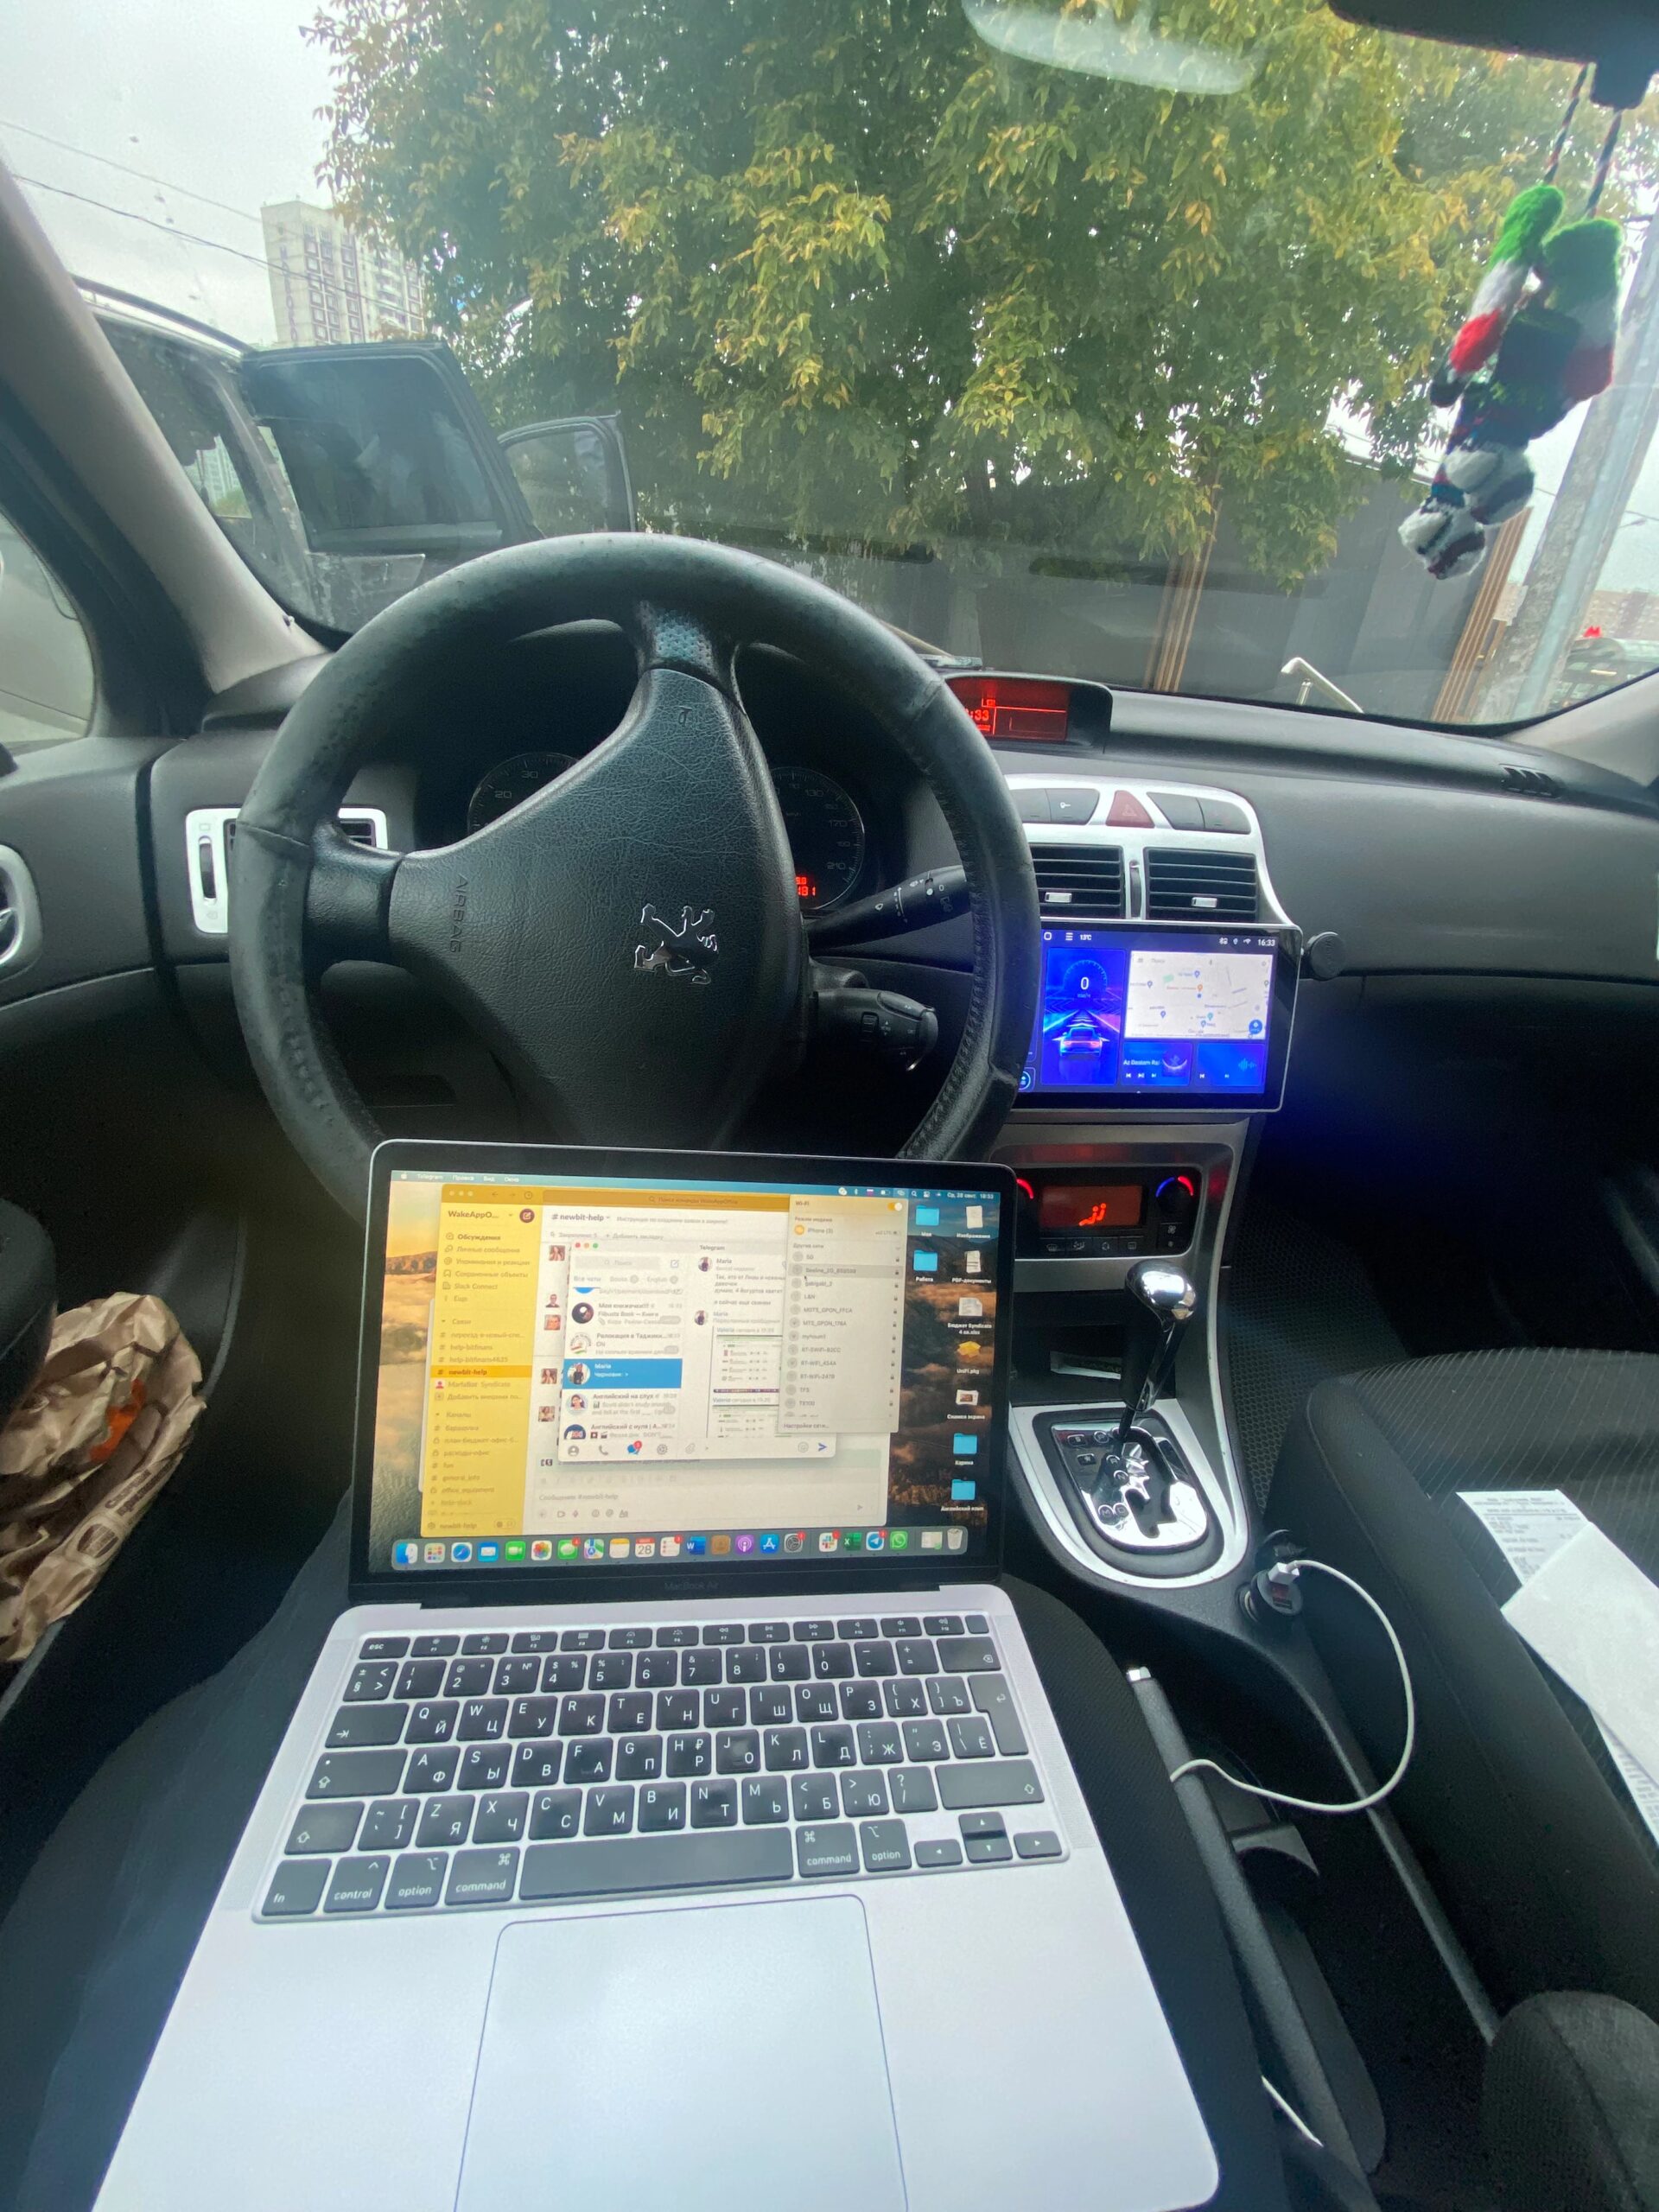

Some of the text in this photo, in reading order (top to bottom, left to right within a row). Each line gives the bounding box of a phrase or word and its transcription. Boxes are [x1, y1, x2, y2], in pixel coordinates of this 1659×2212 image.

[965, 709, 989, 721] :33
[494, 791, 512, 799] 20
[805, 789, 825, 798] 130
[450, 873, 468, 954] AIRBAG
[1257, 938, 1276, 947] 16:33
[1080, 977, 1089, 990] 0
[560, 1213, 604, 1222] newbit-help
[458, 1233, 501, 1242] Обсуждения
[638, 1545, 652, 1554] 28
[407, 1662, 828, 1689] 1 2 3 4 5 6 7 8 9 0
[419, 1707, 429, 1719] Q
[471, 1706, 483, 1715] W
[519, 1703, 527, 1713] E
[569, 1701, 576, 1711] R
[618, 1699, 625, 1708] T
[665, 1696, 672, 1706] Y
[711, 1694, 719, 1704] U
[847, 1687, 853, 1696] P
[418, 1732, 825, 1765] A S D F G H J K L
[431, 1784, 760, 1816] Z X C V B N M
[274, 1852, 900, 1903] fn control option command command option
